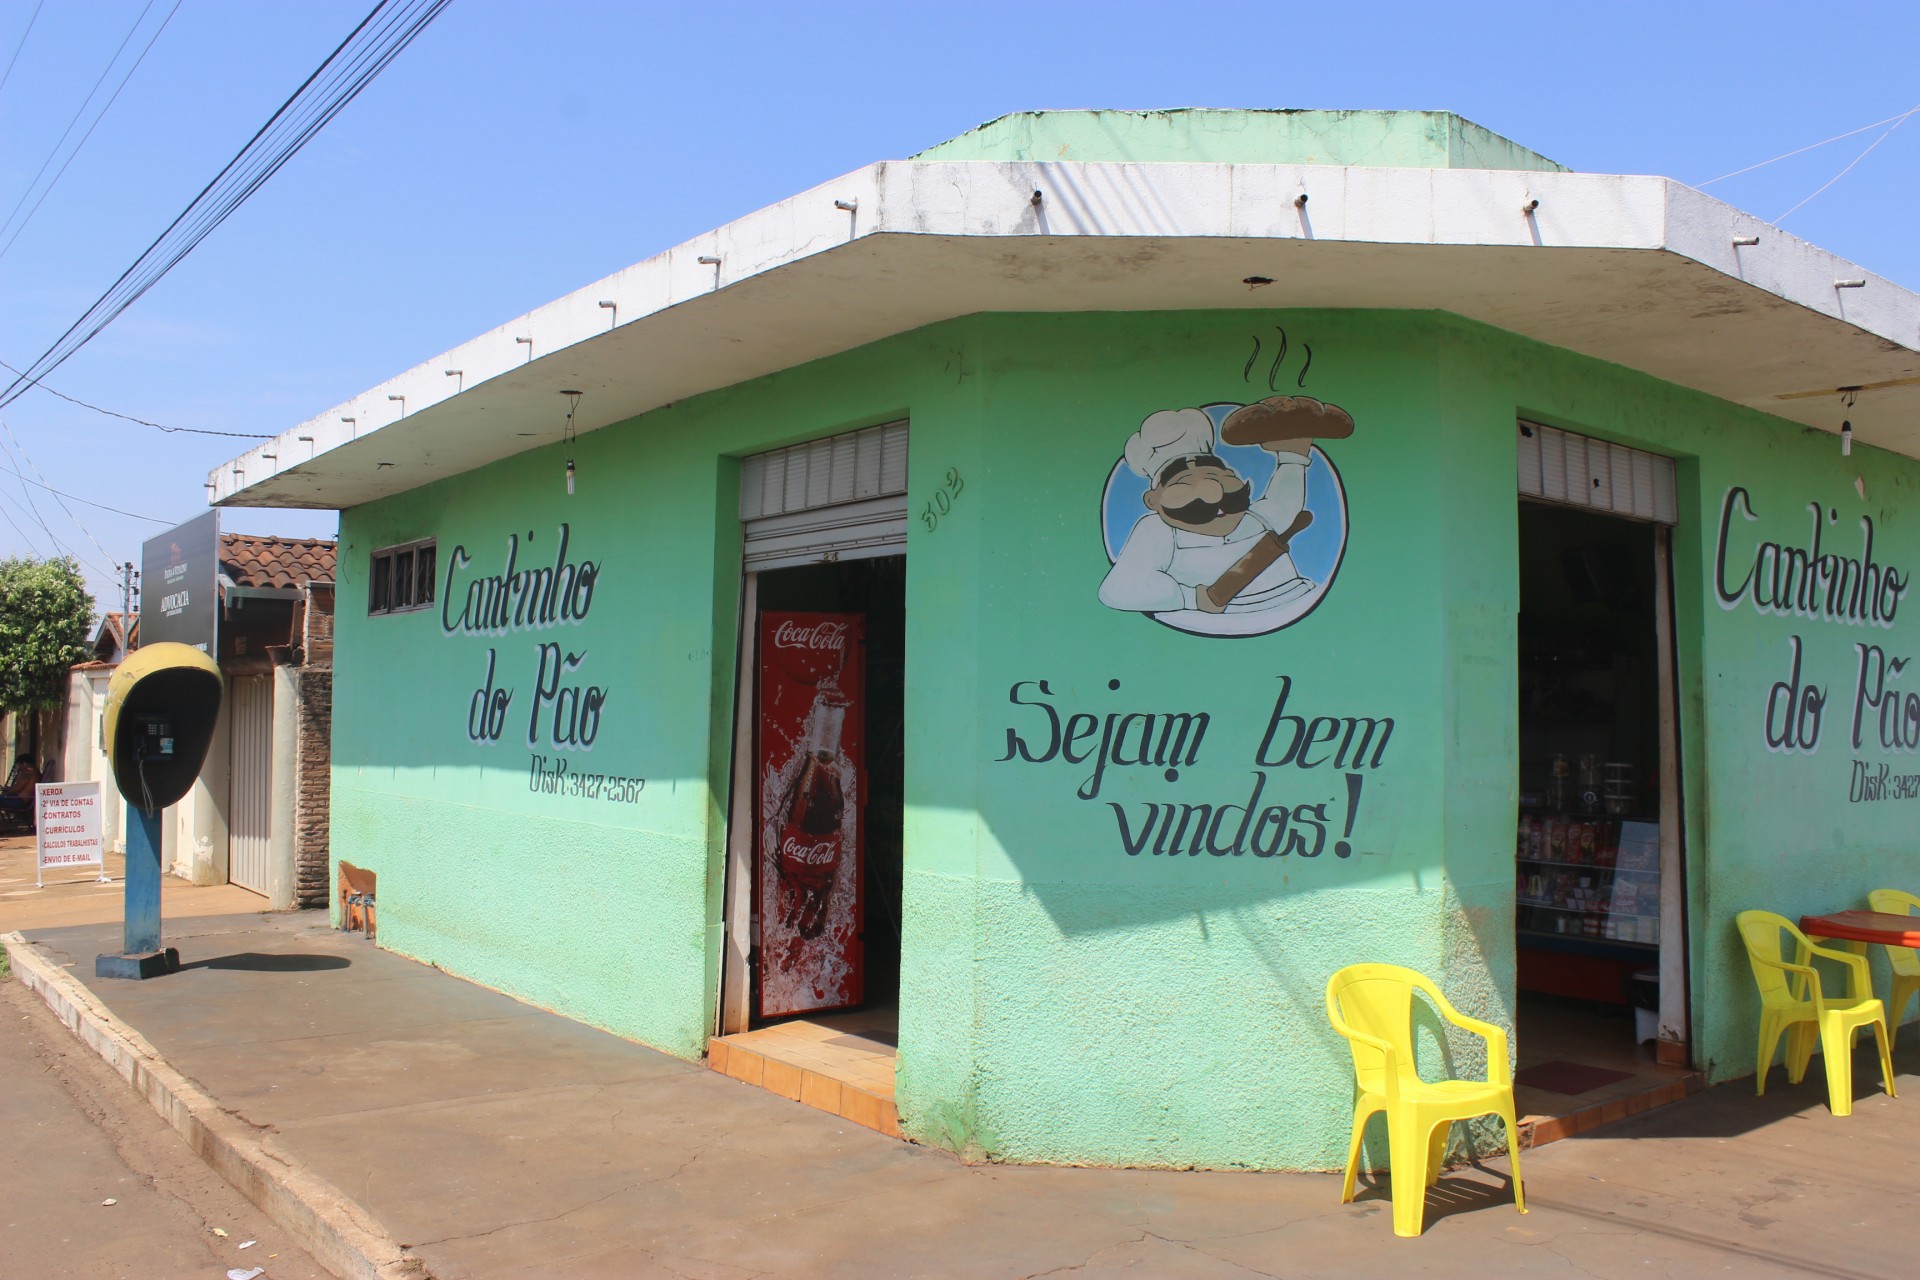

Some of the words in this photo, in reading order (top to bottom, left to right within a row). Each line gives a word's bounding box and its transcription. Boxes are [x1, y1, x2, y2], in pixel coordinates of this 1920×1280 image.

[441, 522, 604, 635] Cantinho
[1714, 486, 1909, 627] Cantinho
[160, 590, 190, 612] ADVOCACIA
[774, 620, 849, 650] Coca-Cola
[468, 647, 515, 743] do
[527, 641, 609, 748] Pão
[1765, 634, 1828, 752] do
[1852, 641, 1920, 752] Pão
[994, 675, 1211, 800] Sejam
[1254, 675, 1395, 769] bem
[50, 799, 60, 807] VIA
[61, 799, 69, 807] DE
[70, 798, 94, 806] CONTAS
[72, 853, 91, 862] E-MAIL
[782, 836, 837, 865] Coca-Cola
